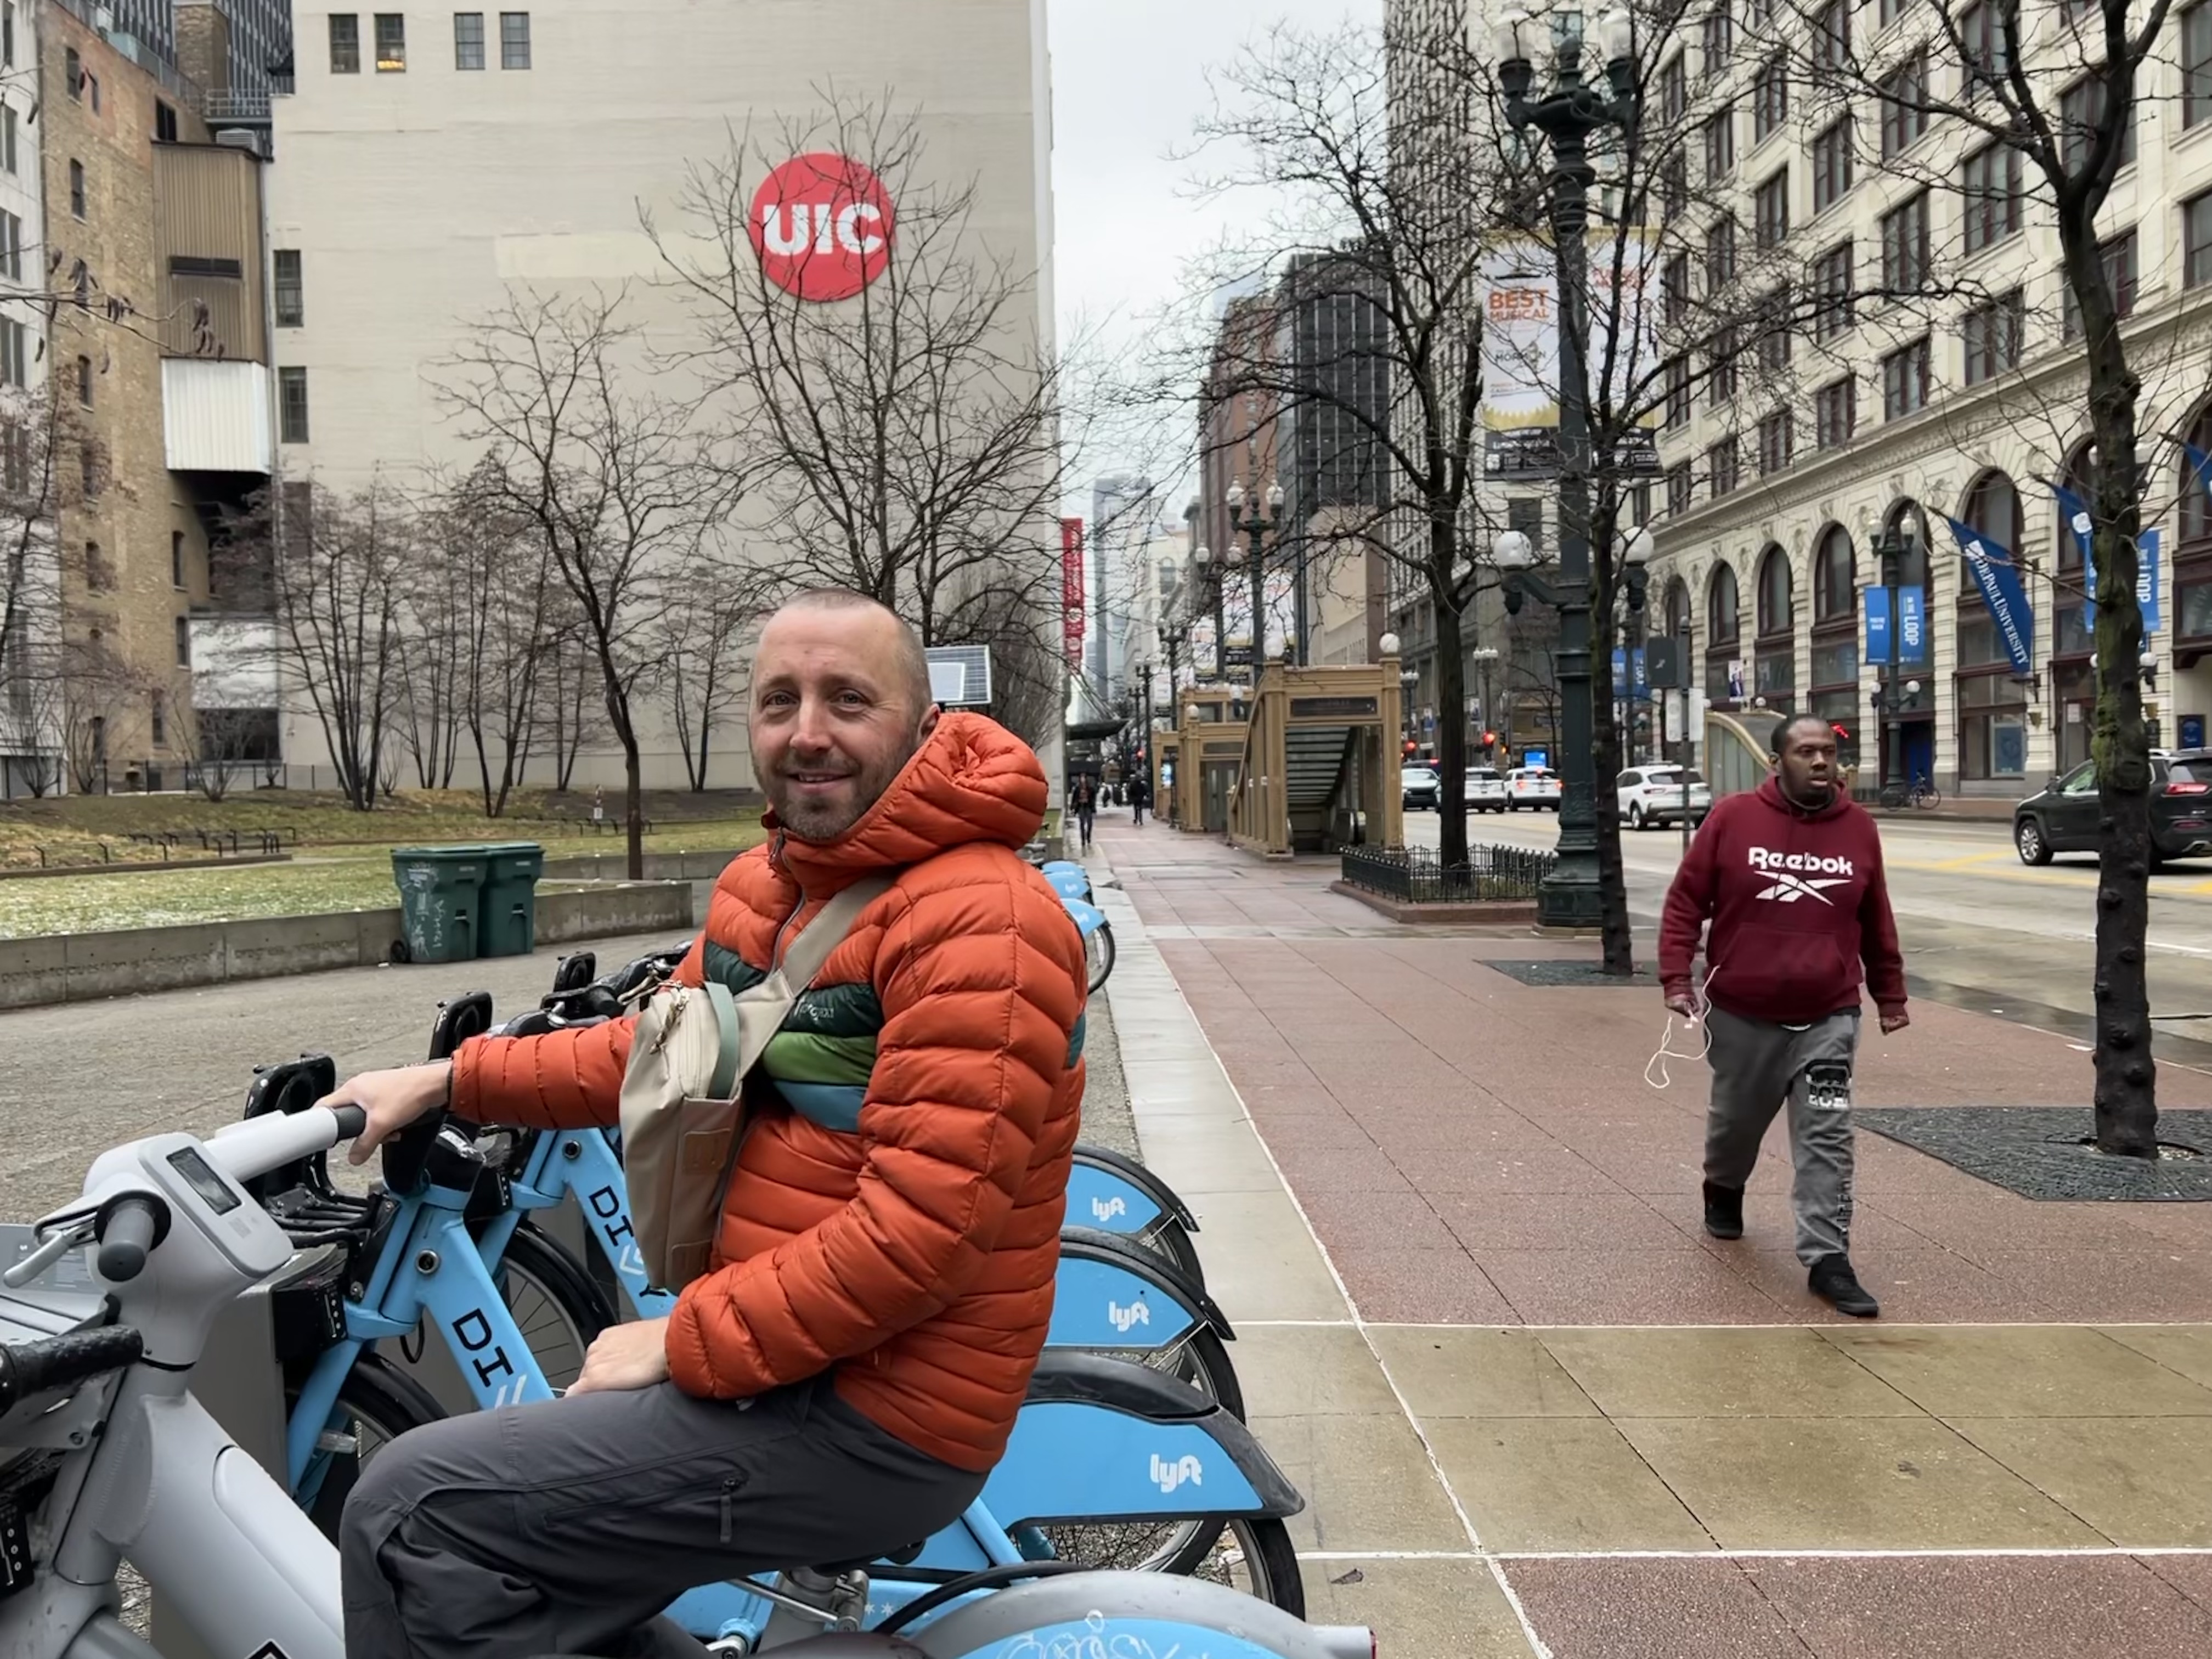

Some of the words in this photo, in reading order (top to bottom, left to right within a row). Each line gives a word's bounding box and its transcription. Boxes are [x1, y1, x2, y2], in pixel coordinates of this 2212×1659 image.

[762, 202, 883, 256] UIC
[1488, 289, 1549, 309] BEST
[1489, 308, 1550, 323] MUSICAL
[1904, 616, 1920, 646] LOOP
[1748, 847, 1854, 876] Reebok
[1092, 1196, 1126, 1221] lyft
[1108, 1301, 1149, 1331] lyft
[1150, 1454, 1202, 1493] lyft
